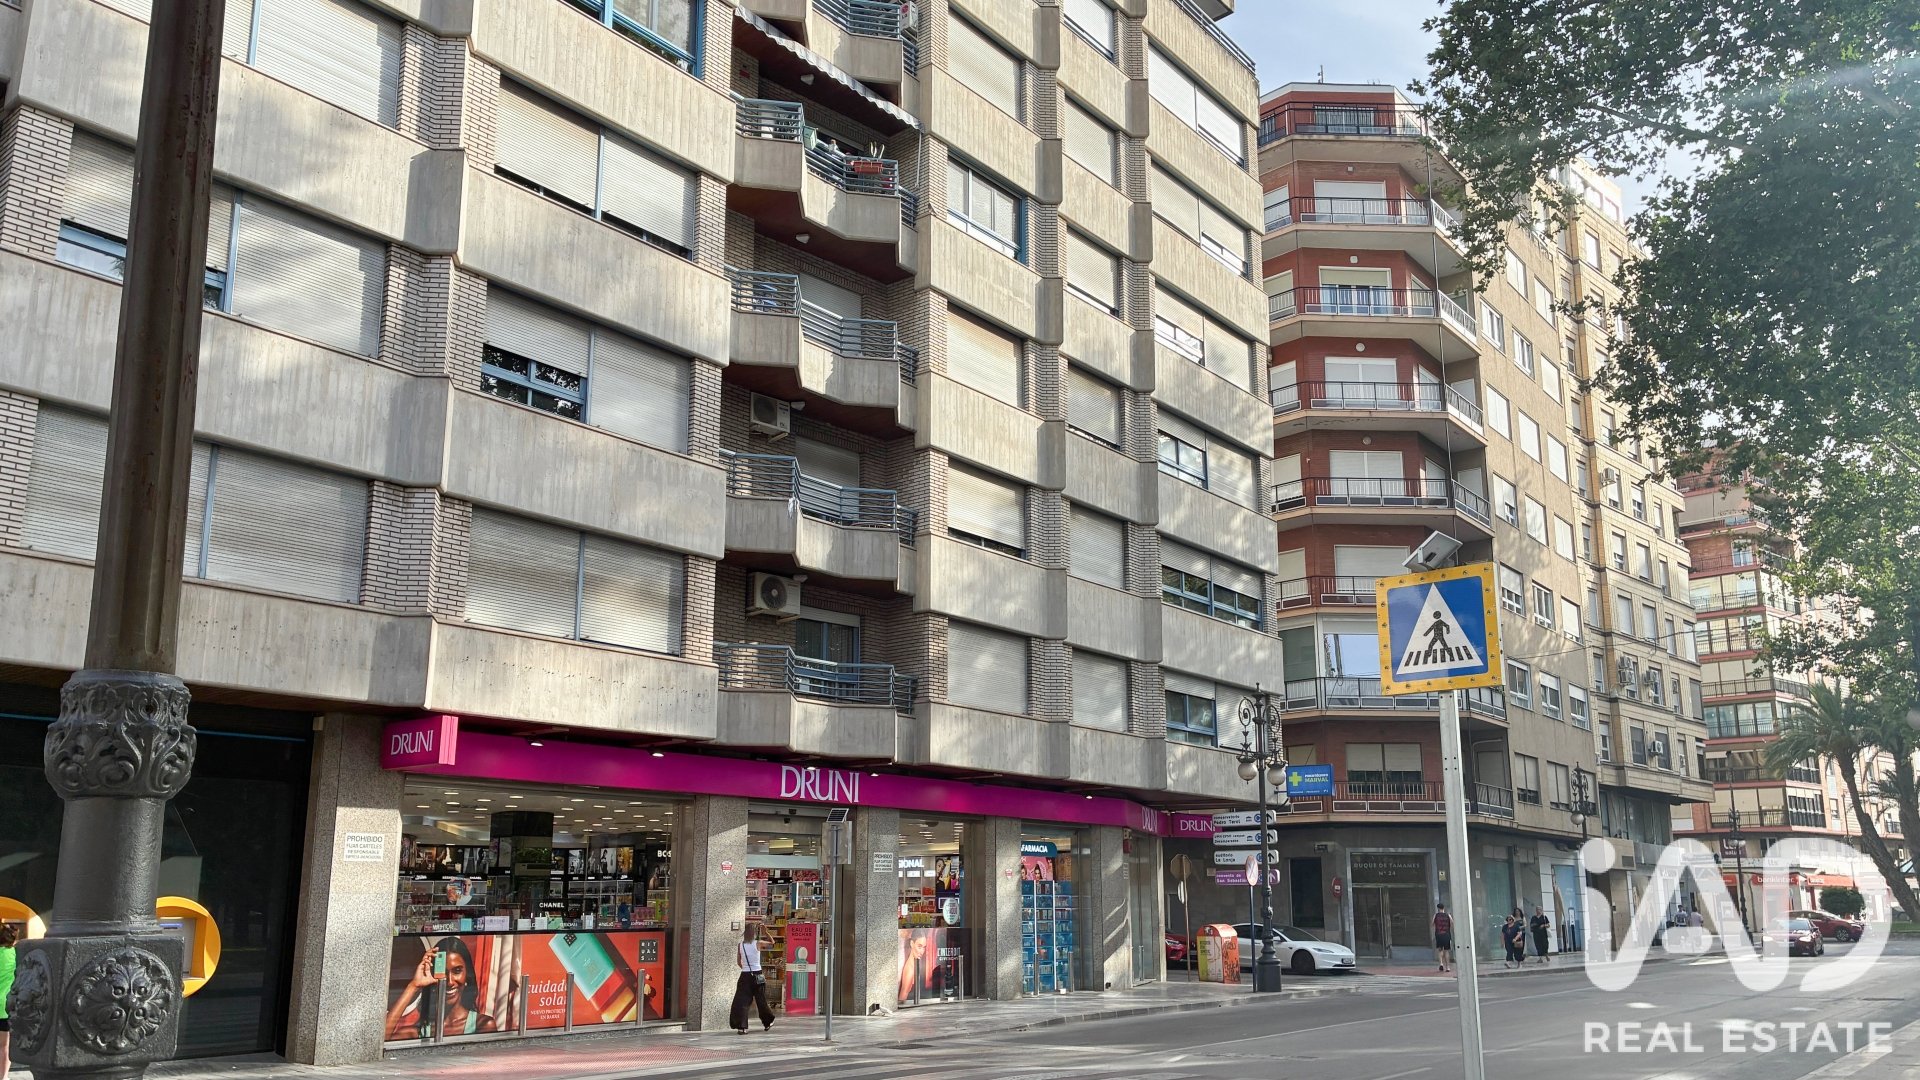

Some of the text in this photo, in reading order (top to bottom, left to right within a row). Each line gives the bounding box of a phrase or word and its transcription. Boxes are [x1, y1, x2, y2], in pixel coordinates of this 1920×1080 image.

[391, 730, 433, 755] DRUNI
[780, 765, 859, 803] DRUNI
[1141, 807, 1158, 833] DRUNI
[528, 979, 567, 994] cuidad
